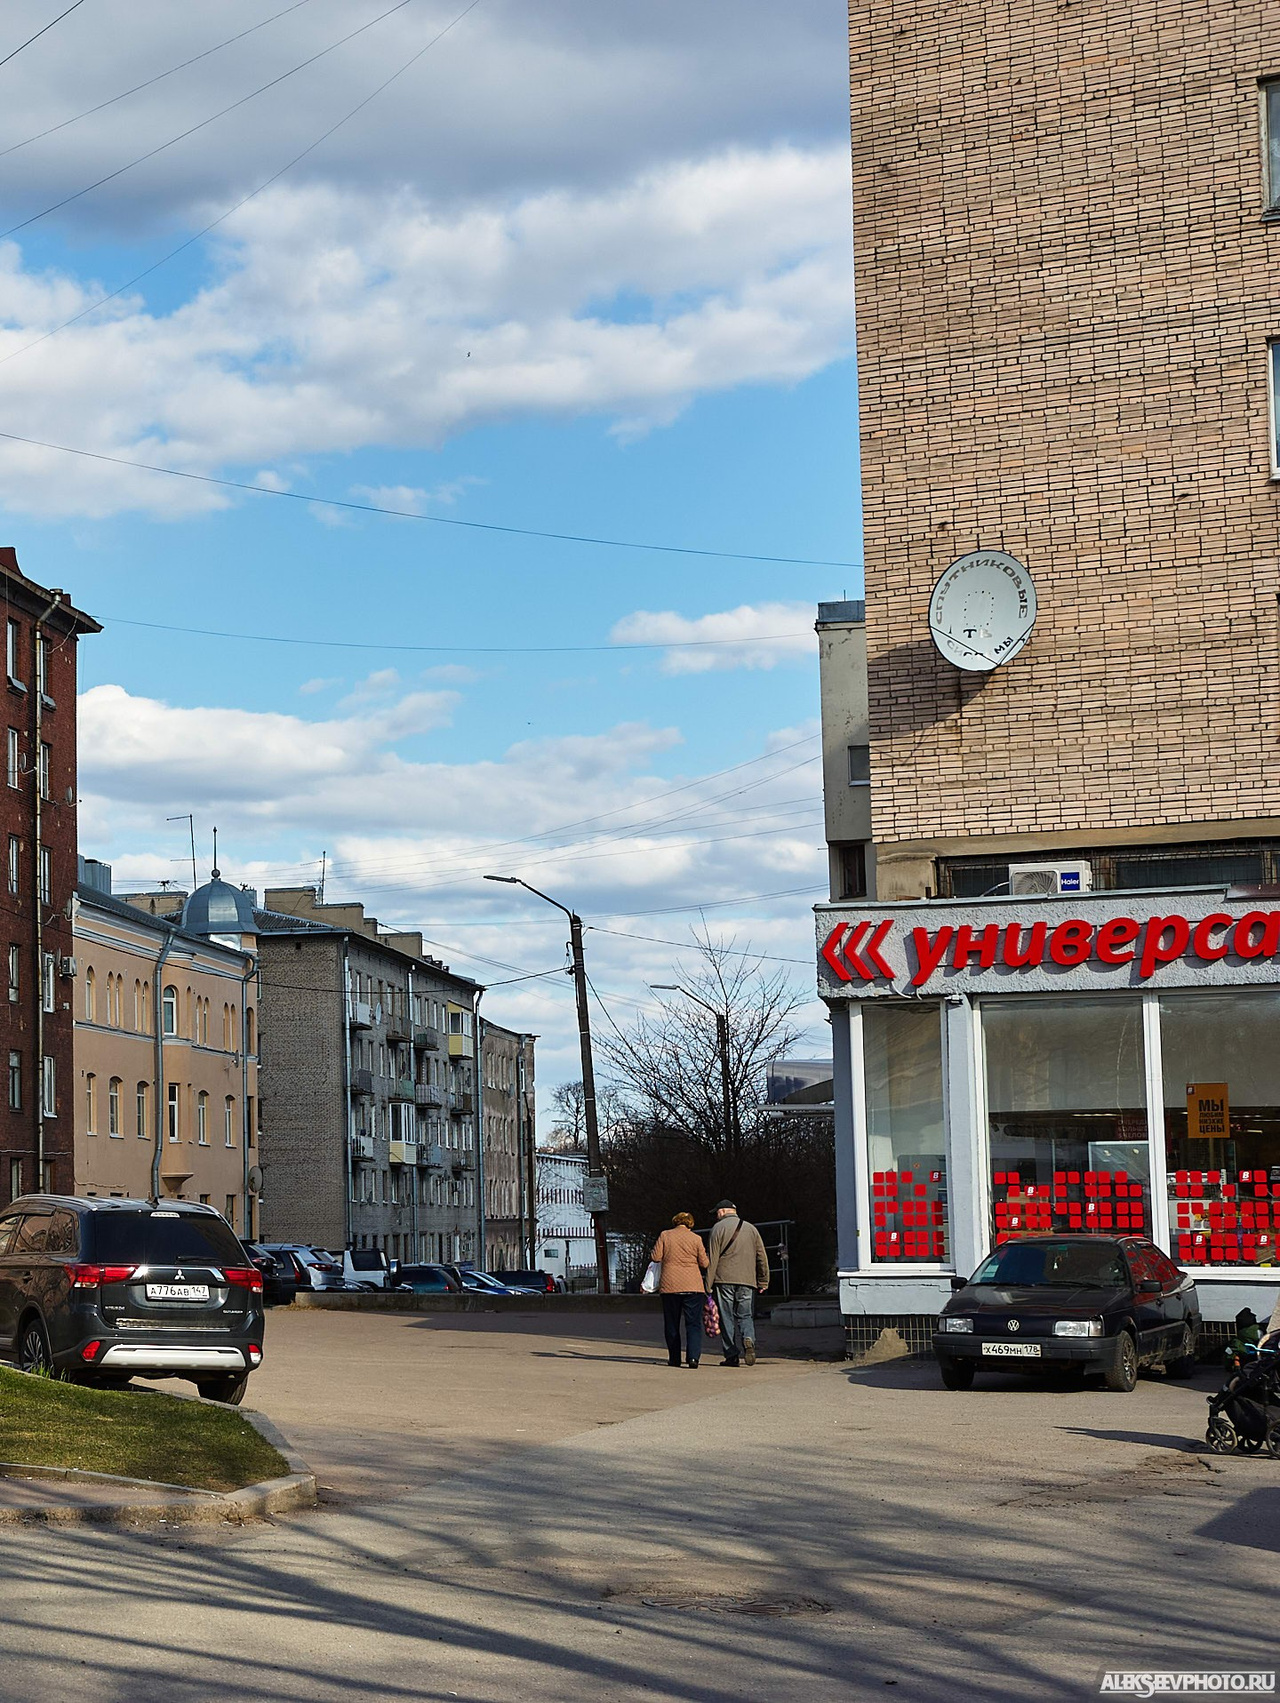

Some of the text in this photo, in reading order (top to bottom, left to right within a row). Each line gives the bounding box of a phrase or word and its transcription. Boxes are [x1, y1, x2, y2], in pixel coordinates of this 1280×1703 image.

[935, 558, 1028, 625] СПУТНИКОВЫЕ
[912, 910, 1280, 986] универса
[1199, 1099, 1224, 1112] МЫ
[1199, 1125, 1225, 1134] ЦЕНЫ
[985, 1345, 1038, 1355] Х469МН 178
